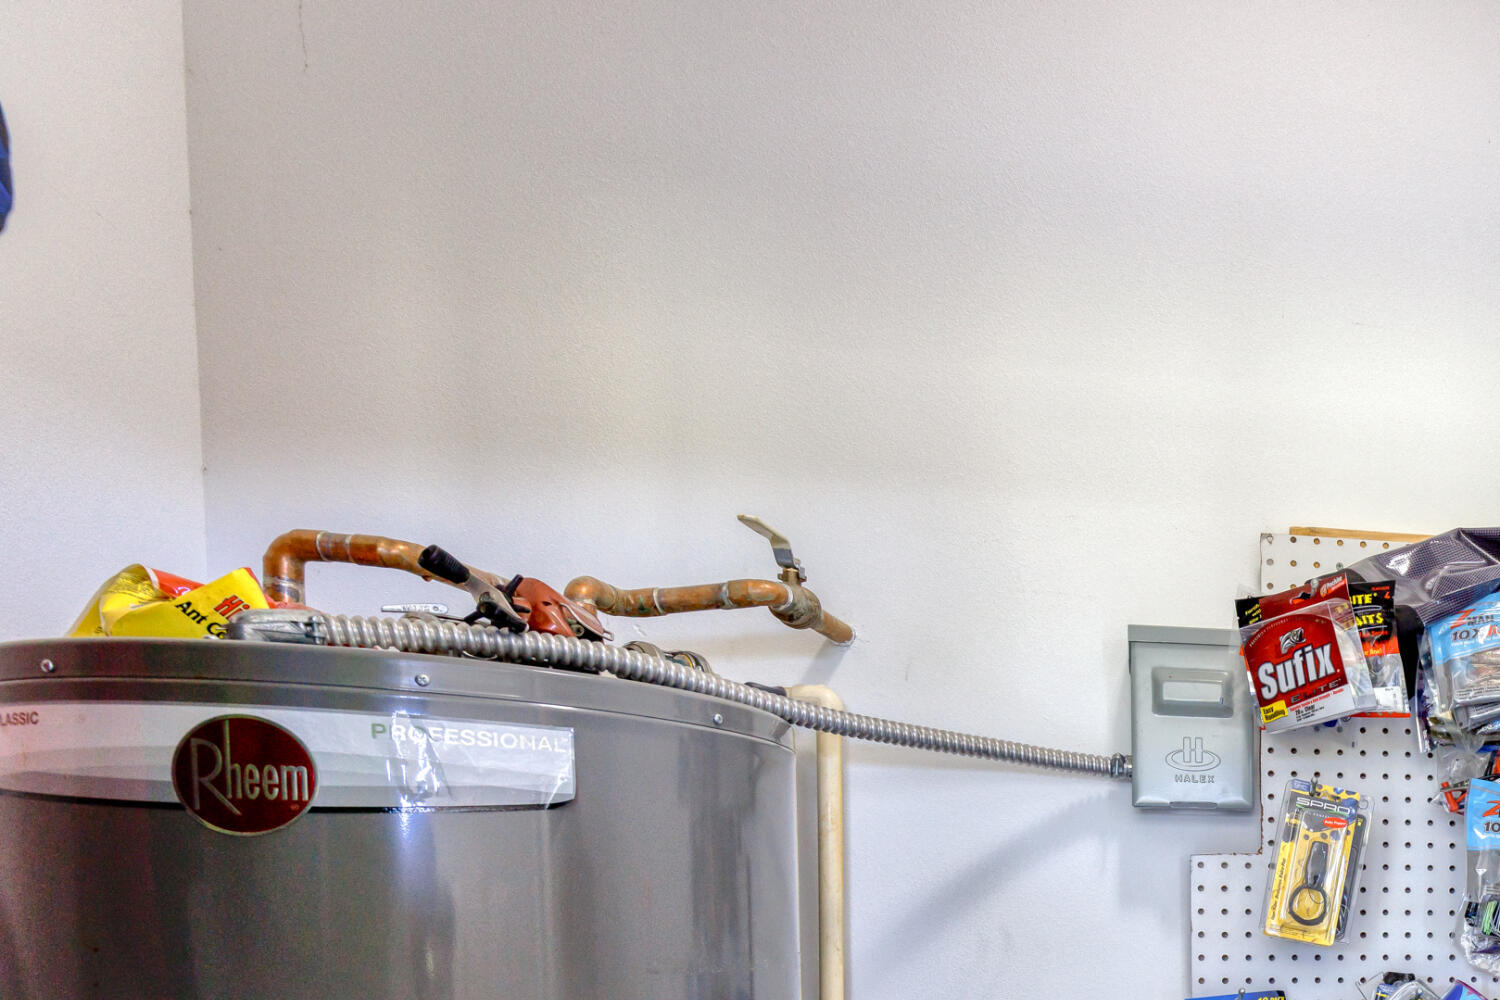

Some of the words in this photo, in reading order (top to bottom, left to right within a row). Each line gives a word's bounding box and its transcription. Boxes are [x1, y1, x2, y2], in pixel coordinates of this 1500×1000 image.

[175, 600, 208, 625] Ant
[1258, 643, 1336, 700] Sufix
[0, 711, 39, 726] LASSIC
[371, 723, 568, 752] PROFESSIONAL
[190, 720, 310, 816] Rheem
[1174, 774, 1216, 784] HALEX
[1296, 797, 1350, 815] SPRO
